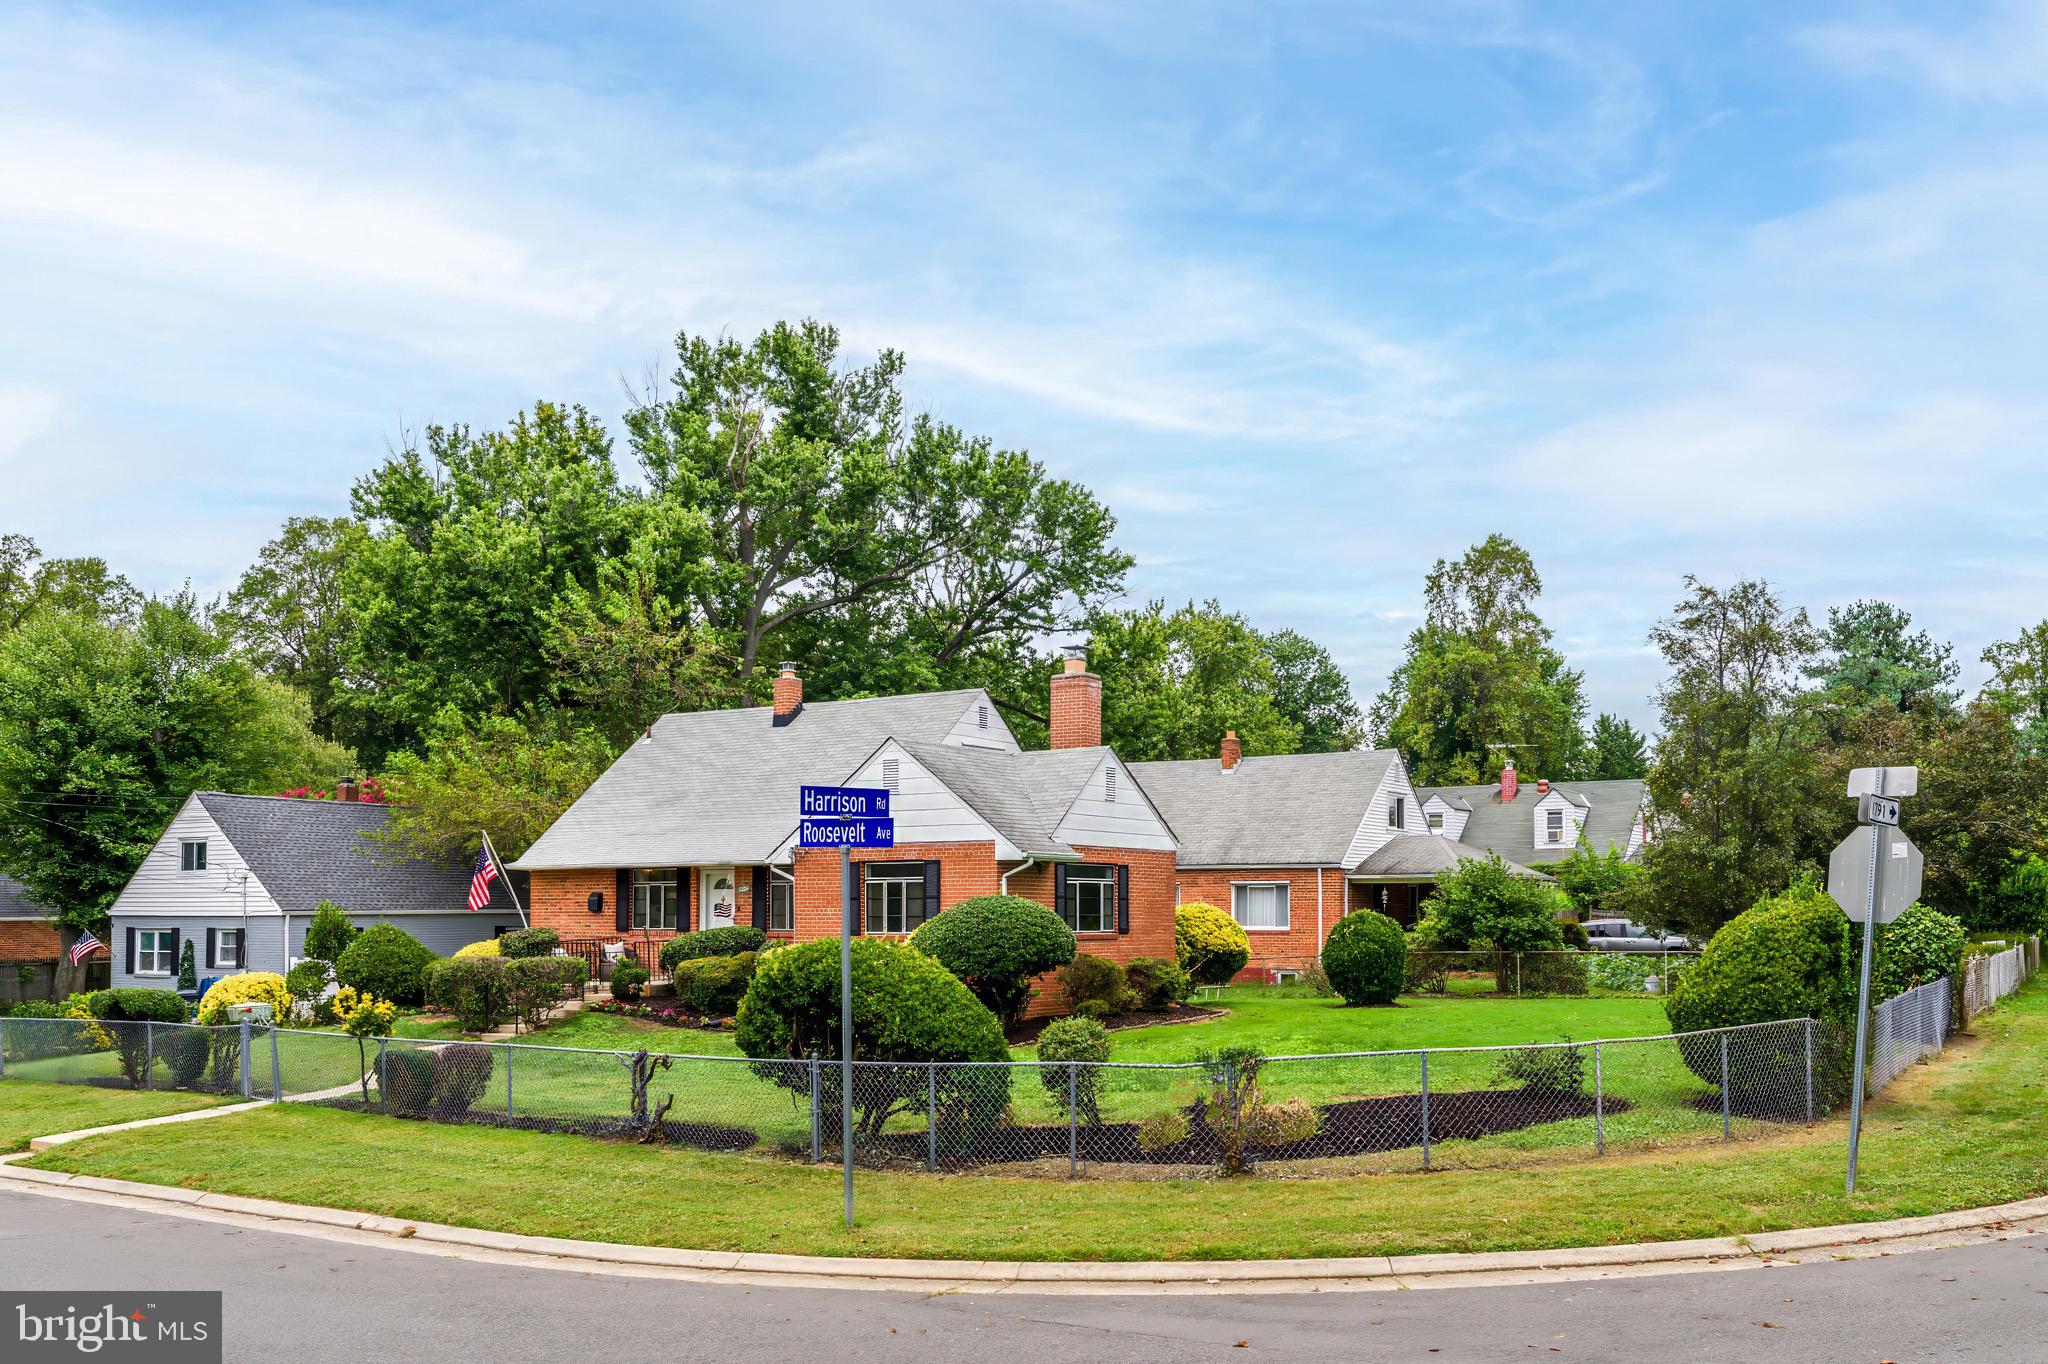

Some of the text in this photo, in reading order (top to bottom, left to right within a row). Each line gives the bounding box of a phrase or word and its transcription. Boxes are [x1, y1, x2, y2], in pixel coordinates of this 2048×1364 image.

[804, 789, 886, 813] Harrison Rd
[803, 822, 891, 843] Roosevelt Ave
